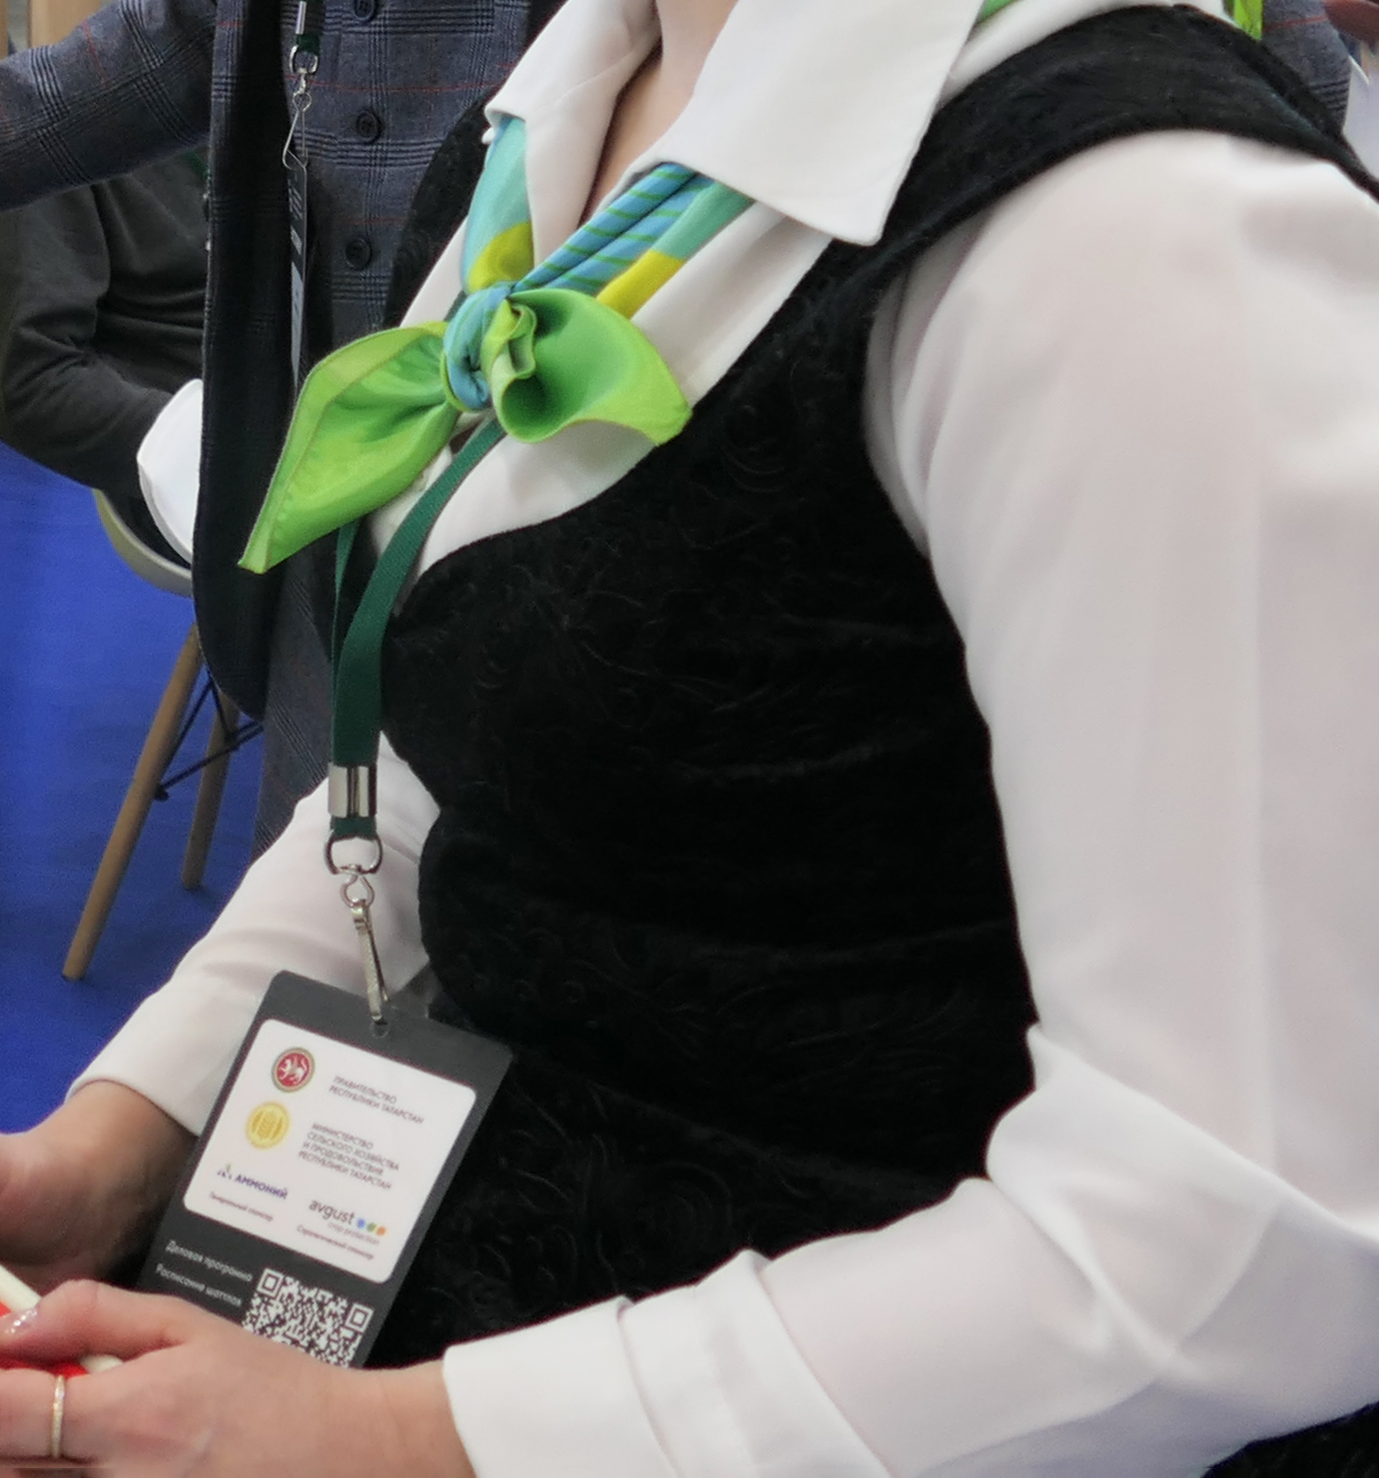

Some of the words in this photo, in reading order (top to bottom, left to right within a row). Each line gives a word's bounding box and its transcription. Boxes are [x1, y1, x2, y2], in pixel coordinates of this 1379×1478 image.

[328, 1085, 381, 1111] РЕСПУБЛИКИ
[381, 1103, 425, 1125] ТАТАРСТАН
[333, 1075, 397, 1105] ПРАВИТЕЛЬСТВО
[311, 1122, 374, 1150] МИНИСТЕРСТВО
[306, 1132, 353, 1155] СЕЛЬСКОГО
[352, 1148, 400, 1172] ХОЗЯЙСТВА
[234, 1172, 289, 1200] АММОНИЙ
[298, 1151, 349, 1176] РЕСПУБЛИКИ
[349, 1168, 392, 1191] ТАТАРСТАН
[309, 1199, 356, 1225] avgust
